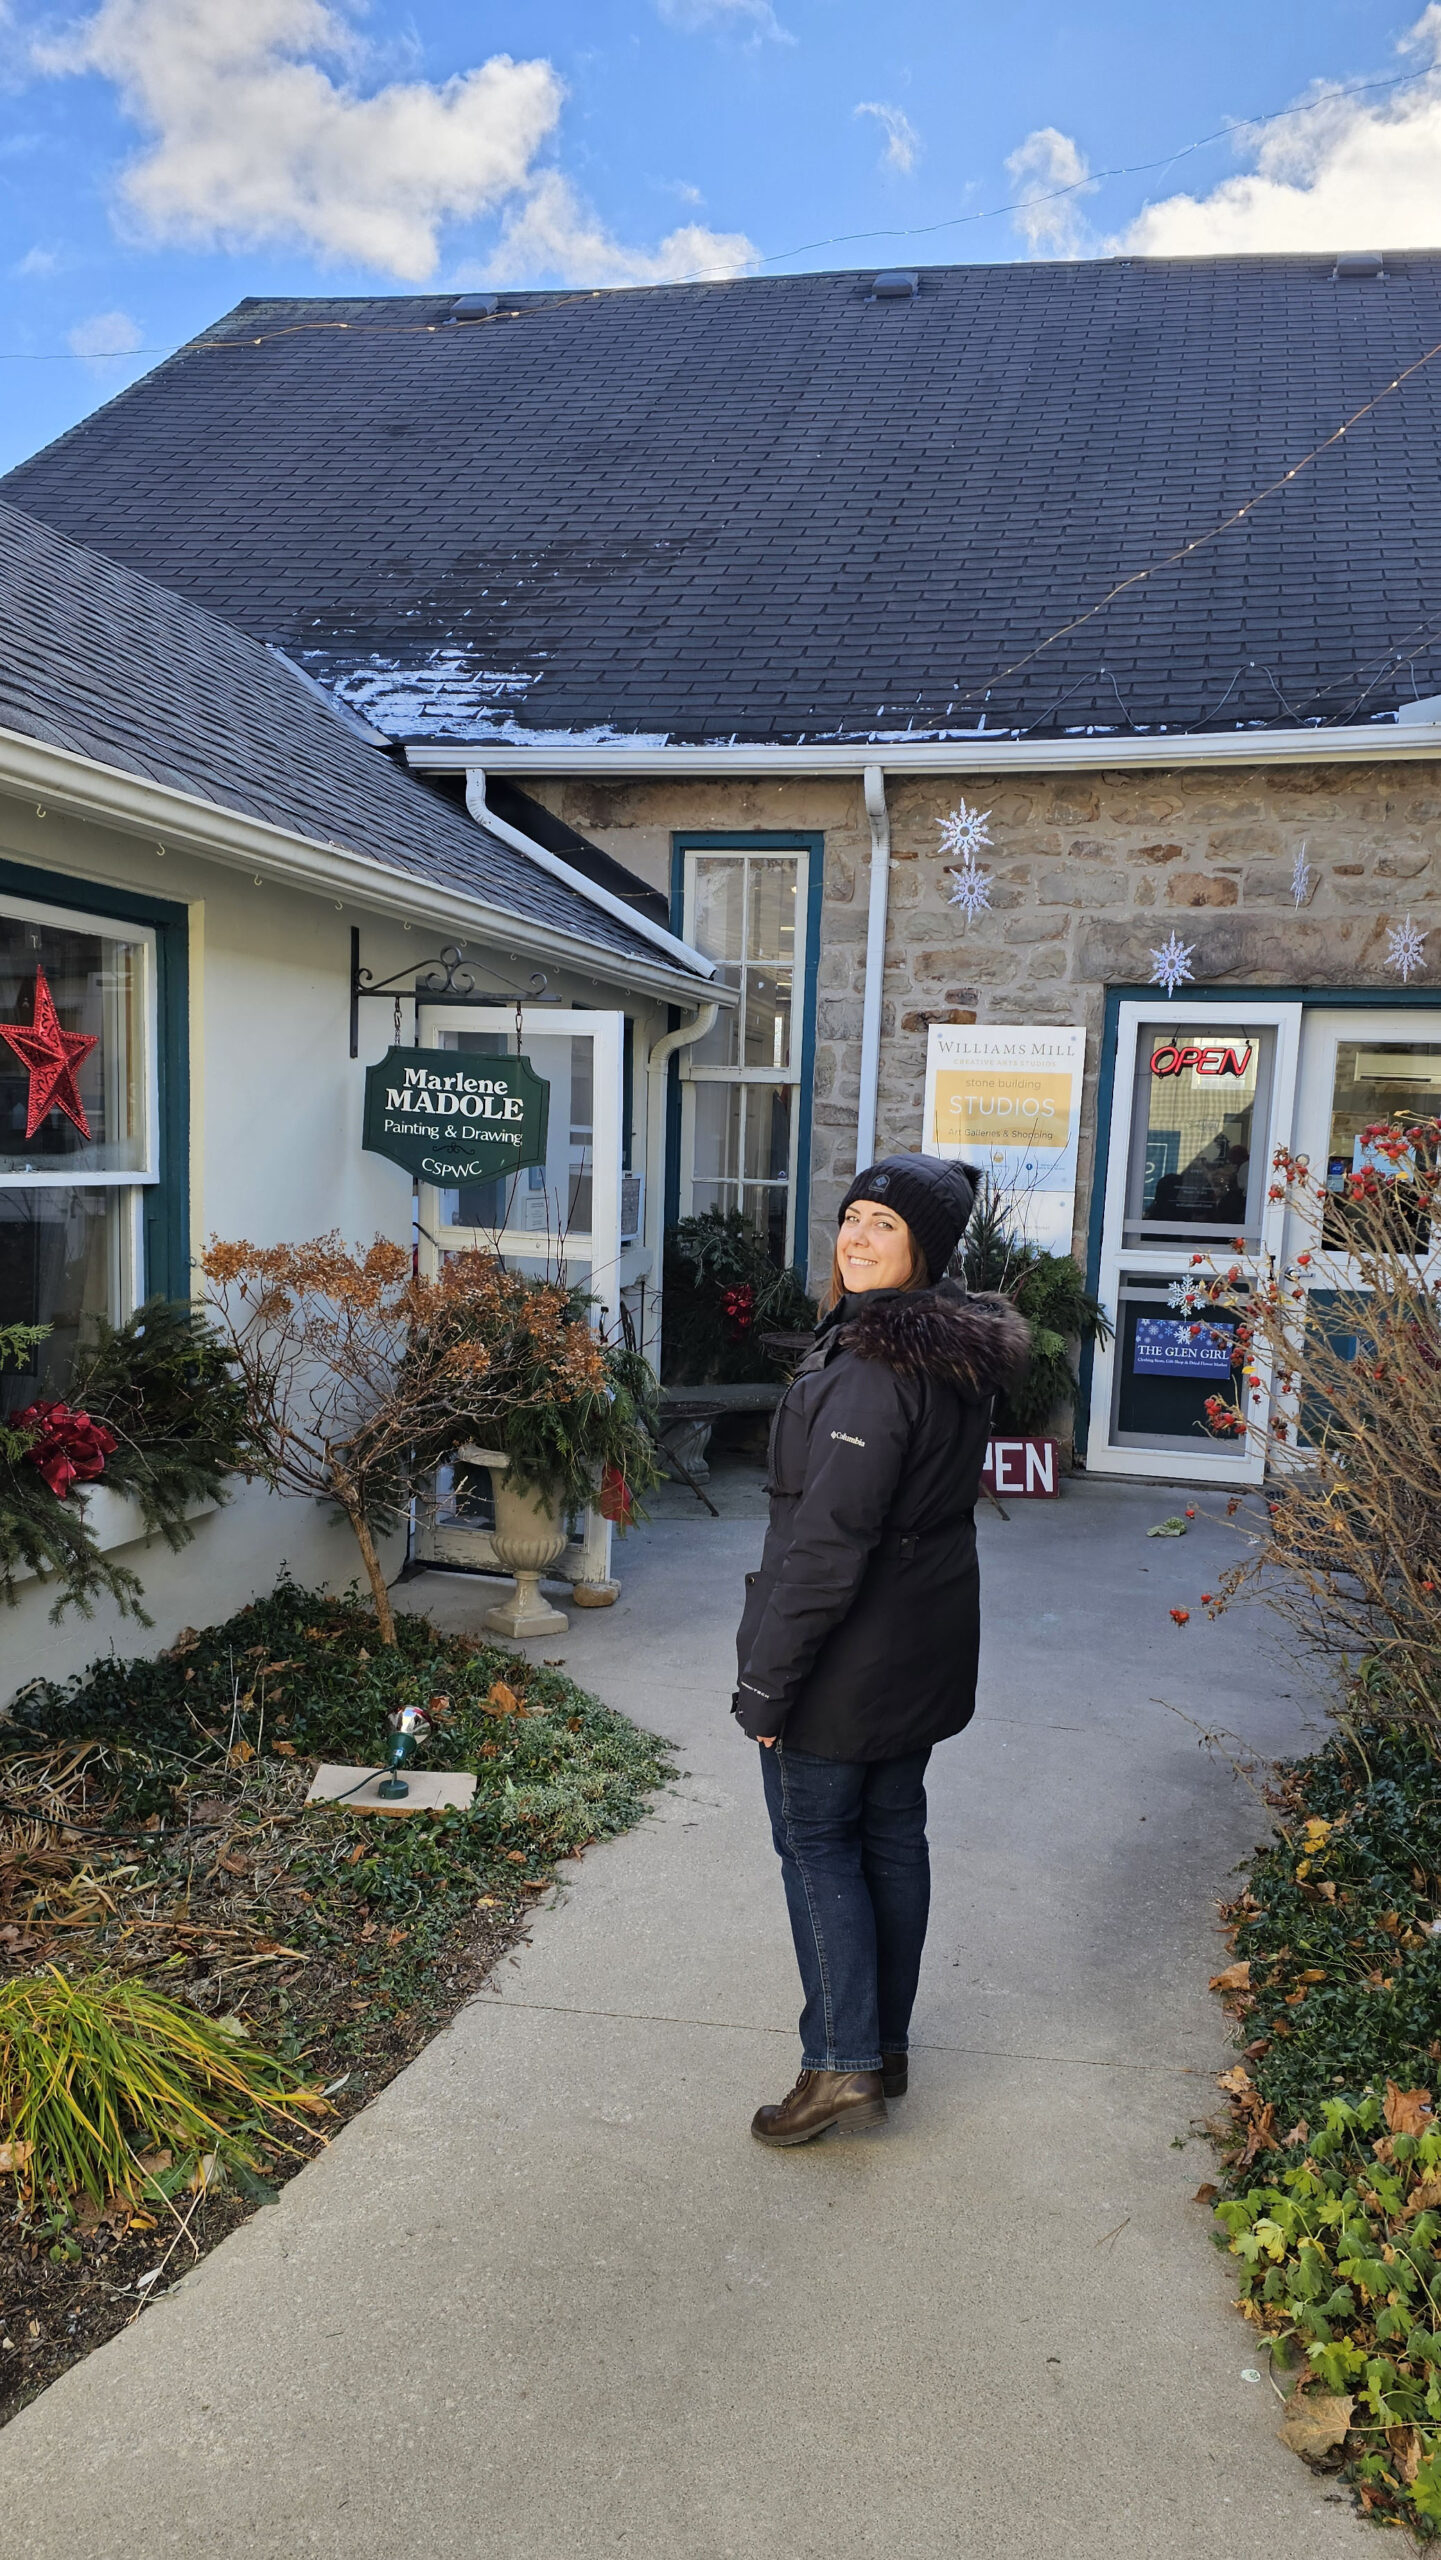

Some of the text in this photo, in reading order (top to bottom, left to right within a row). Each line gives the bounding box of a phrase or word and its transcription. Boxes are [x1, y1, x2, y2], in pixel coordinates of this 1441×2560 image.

[938, 1041, 1076, 1056] WILLIAMS MILL
[1150, 1045, 1252, 1076] OPEN
[403, 1067, 508, 1095] Marlene
[965, 1078, 1042, 1091] stone building
[384, 1088, 524, 1121] MADOLE
[949, 1095, 1055, 1117] STUDIOS
[384, 1119, 523, 1147] Painting & Drawing
[948, 1128, 1053, 1140] Art Galleries & Shopping
[421, 1157, 482, 1178] CSPWC
[1137, 1345, 1230, 1360] THE GLEN GIRL
[983, 1442, 1053, 1492] EN
